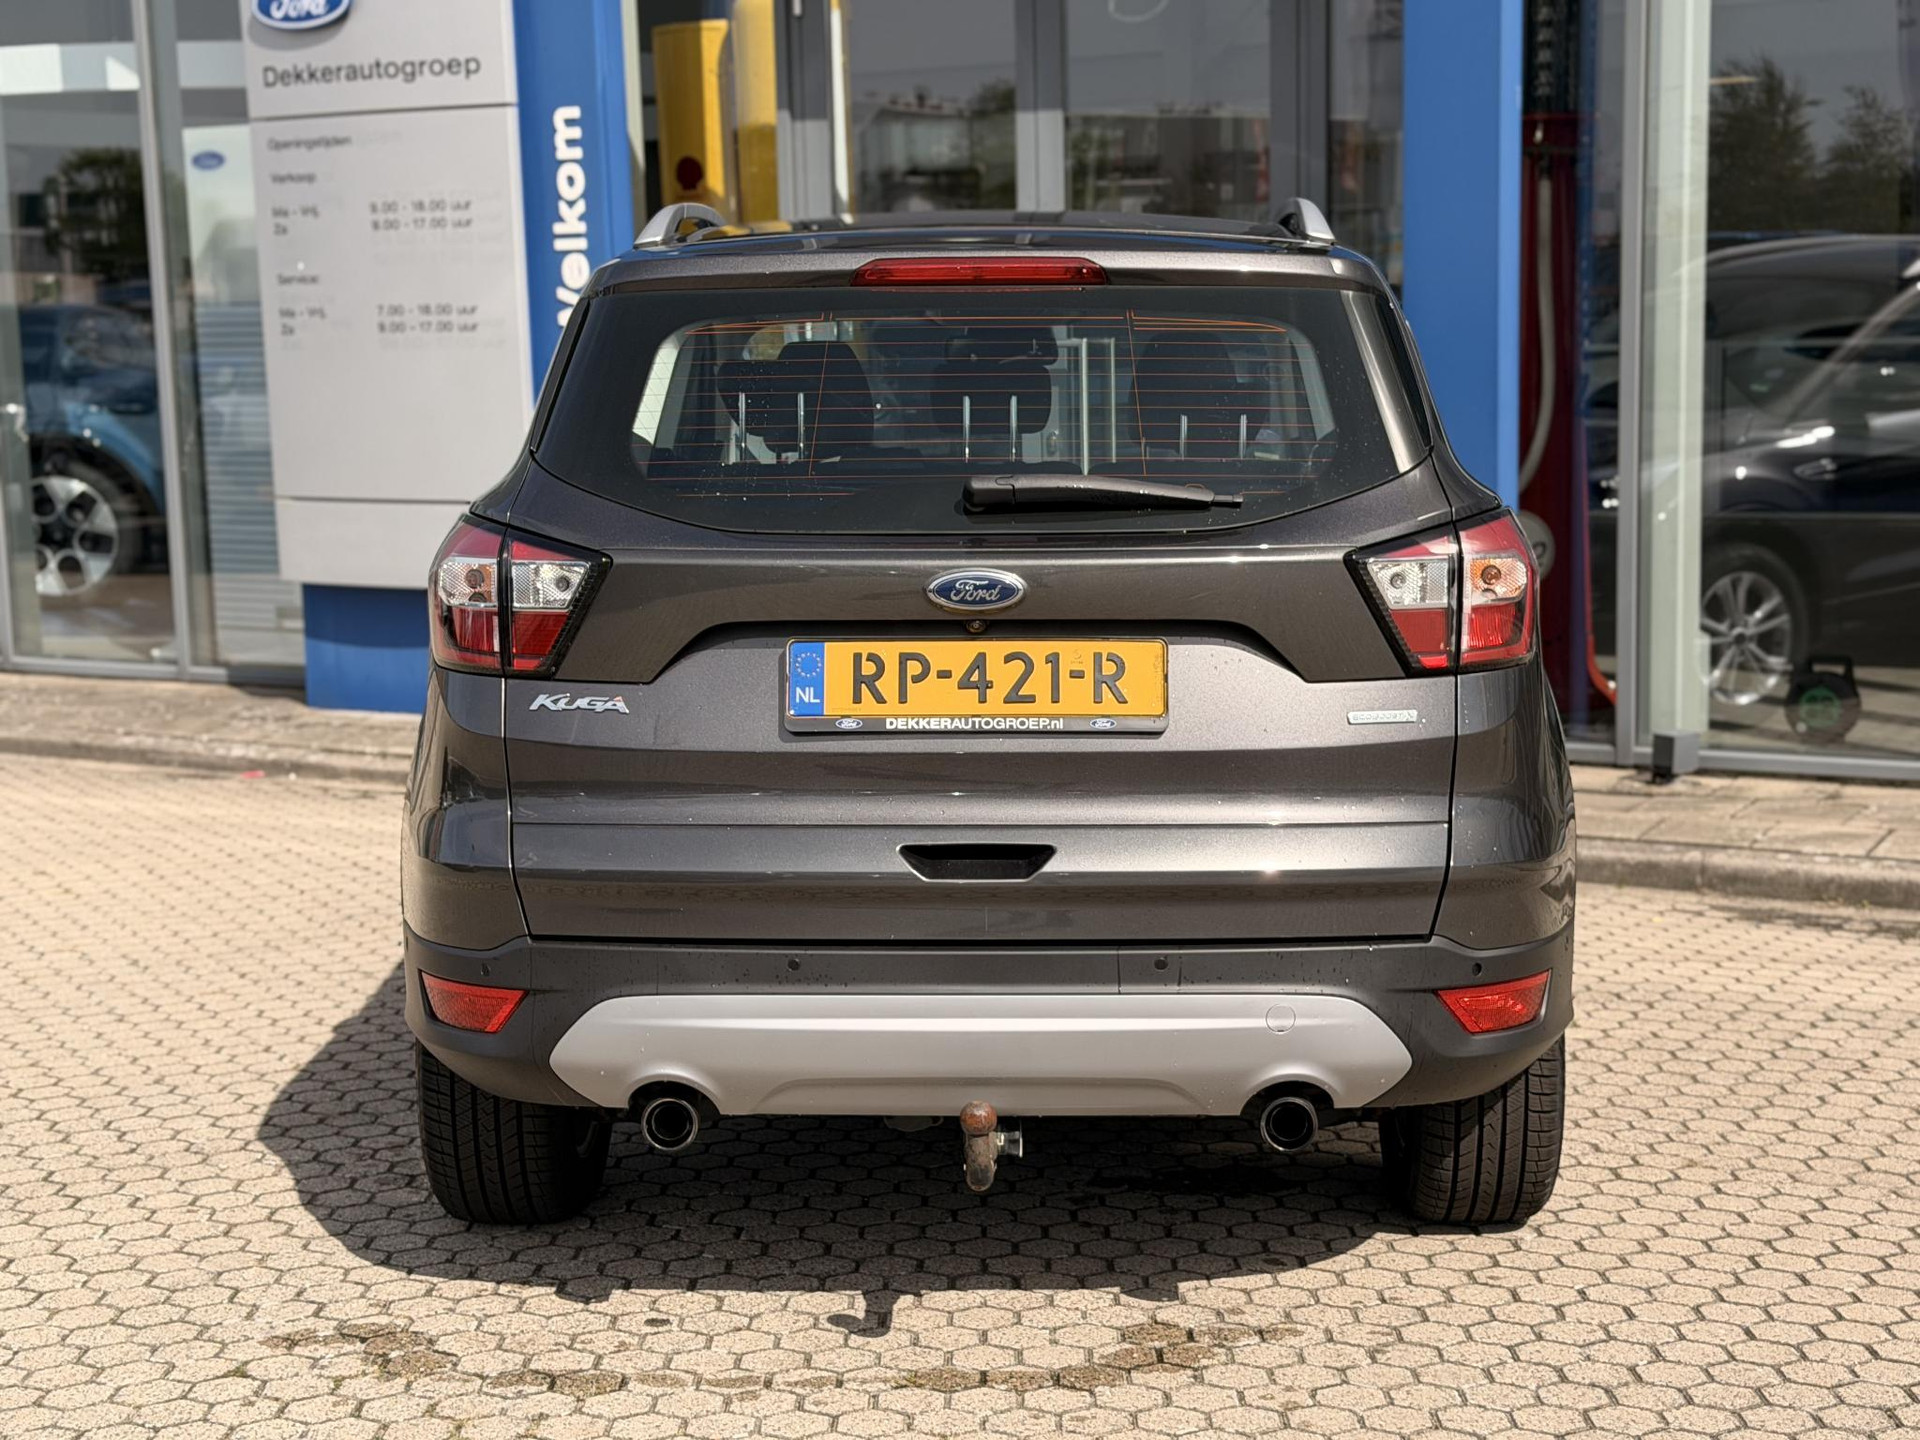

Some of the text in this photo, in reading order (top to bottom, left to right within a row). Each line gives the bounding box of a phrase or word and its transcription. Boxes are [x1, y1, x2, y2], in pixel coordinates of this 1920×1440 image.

[262, 57, 481, 88] Dekkerautogroep
[450, 200, 471, 212] uur
[413, 217, 449, 230] 17.00
[452, 217, 473, 229] uur
[456, 305, 478, 316] uur
[419, 320, 454, 333] 17.00
[457, 322, 479, 333] uur
[950, 579, 1001, 601] Ford
[852, 651, 1128, 705] RP-421-R
[795, 686, 821, 704] NL
[529, 693, 630, 714] KUGA
[885, 717, 1064, 730] DEKKERAUTOGROEP.nl
